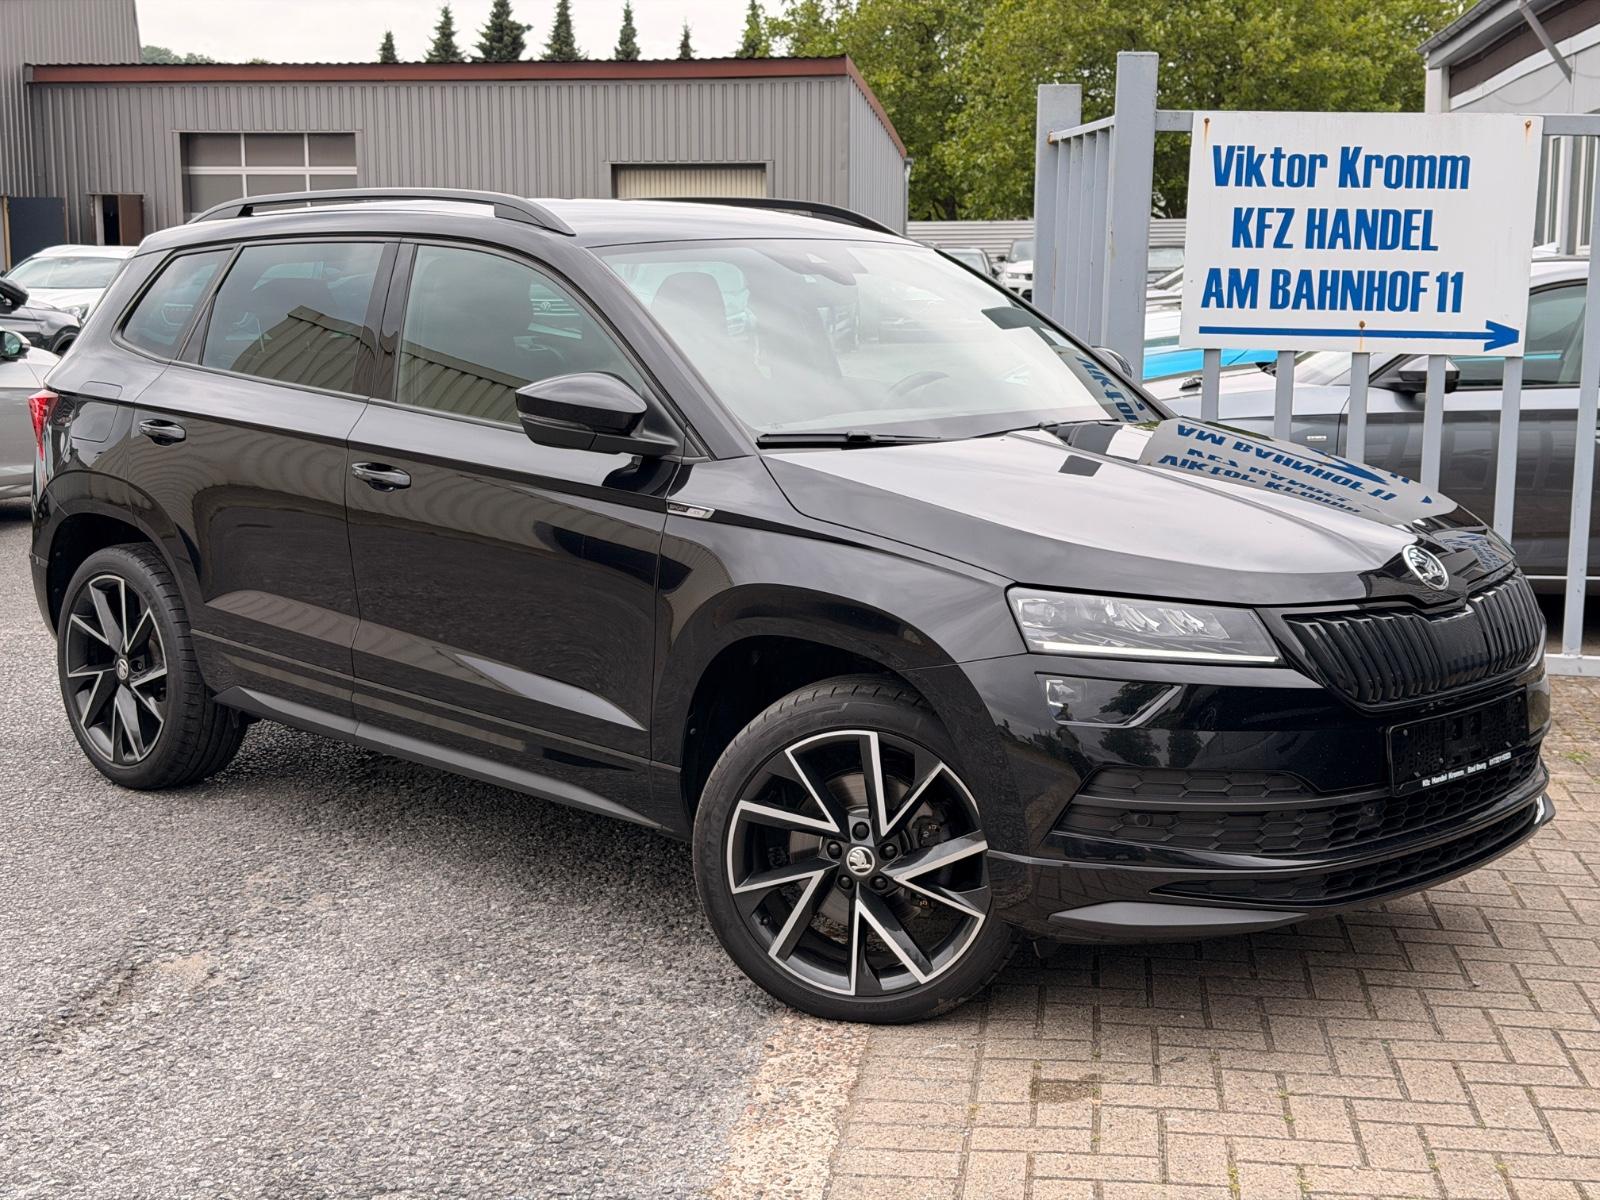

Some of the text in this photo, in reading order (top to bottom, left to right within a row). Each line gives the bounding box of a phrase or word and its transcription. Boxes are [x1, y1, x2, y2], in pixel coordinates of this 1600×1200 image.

[1212, 145, 1471, 190] Viktor Kromm
[1231, 207, 1439, 251] KFZ HANDEL
[1201, 267, 1464, 313] AM BAHNHOF 11
